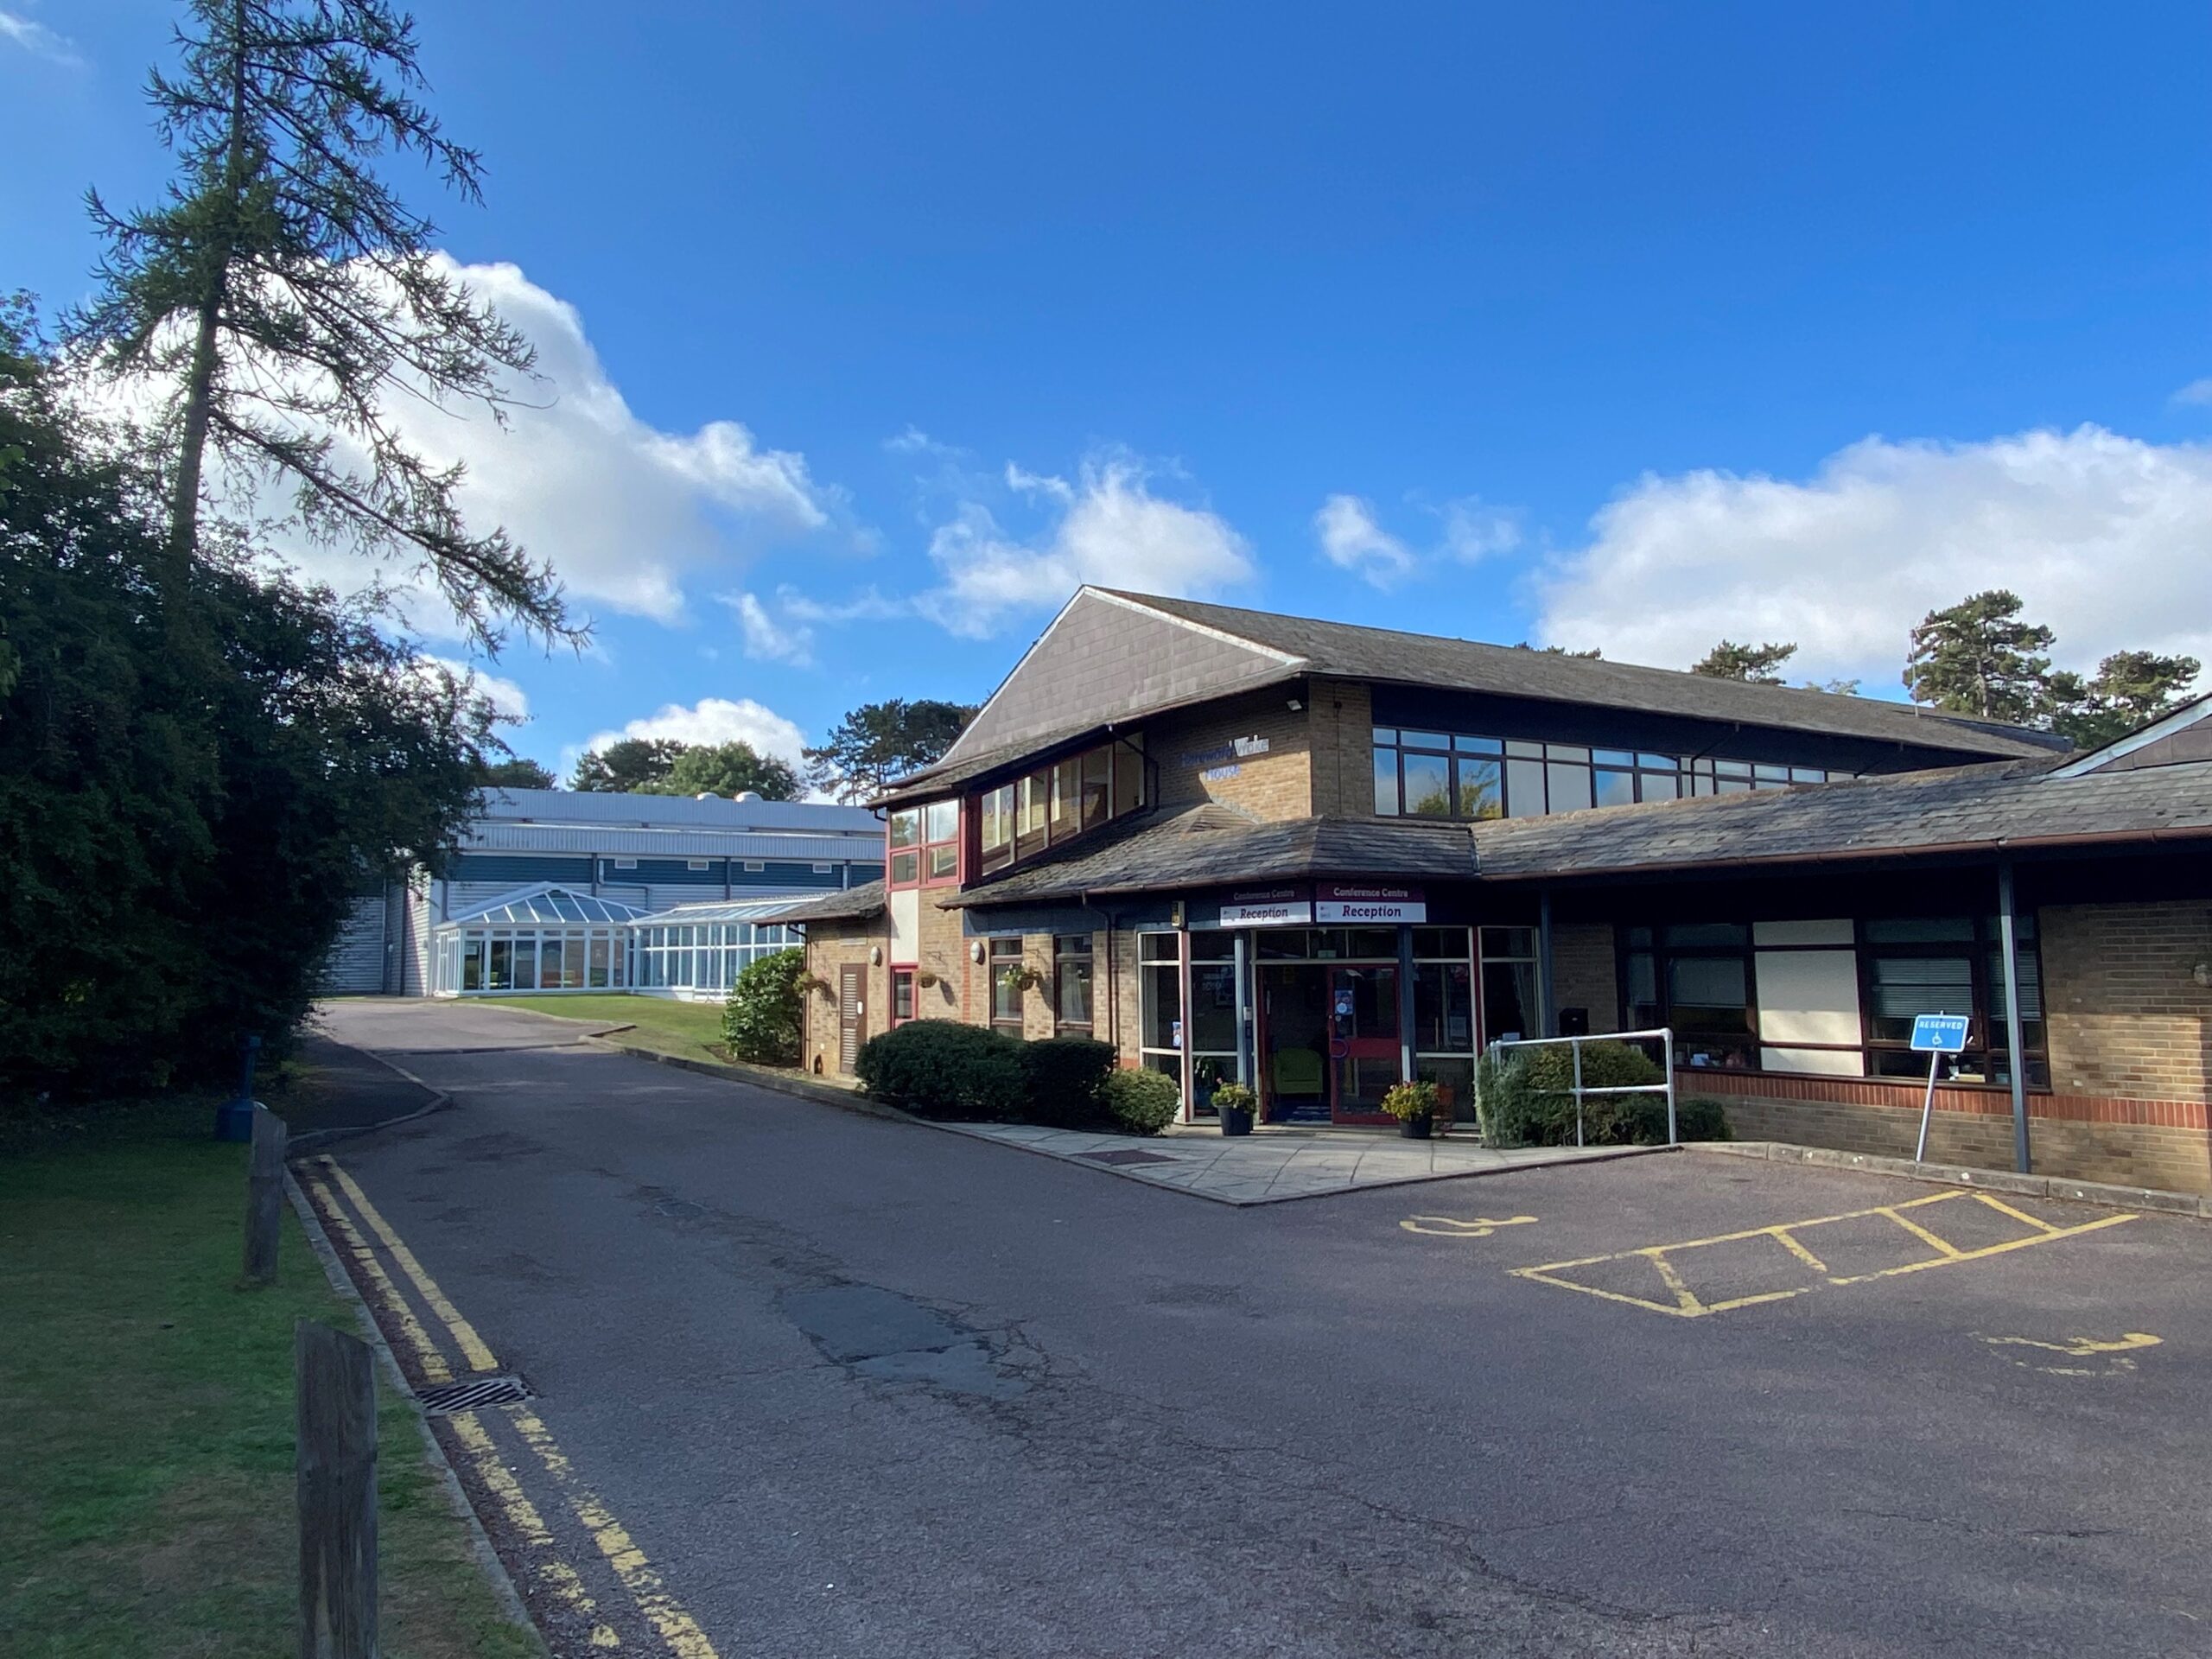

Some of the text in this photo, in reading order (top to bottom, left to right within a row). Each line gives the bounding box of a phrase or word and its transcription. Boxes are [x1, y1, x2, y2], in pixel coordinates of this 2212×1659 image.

[1234, 734, 1269, 757] Wake
[1205, 765, 1242, 781] House
[1234, 889, 1295, 900] Conference Centre
[1333, 887, 1408, 898] Conference Centre
[1240, 907, 1288, 921] Reception
[1342, 905, 1402, 919] Reception
[1918, 1020, 1963, 1030] RESERVED
